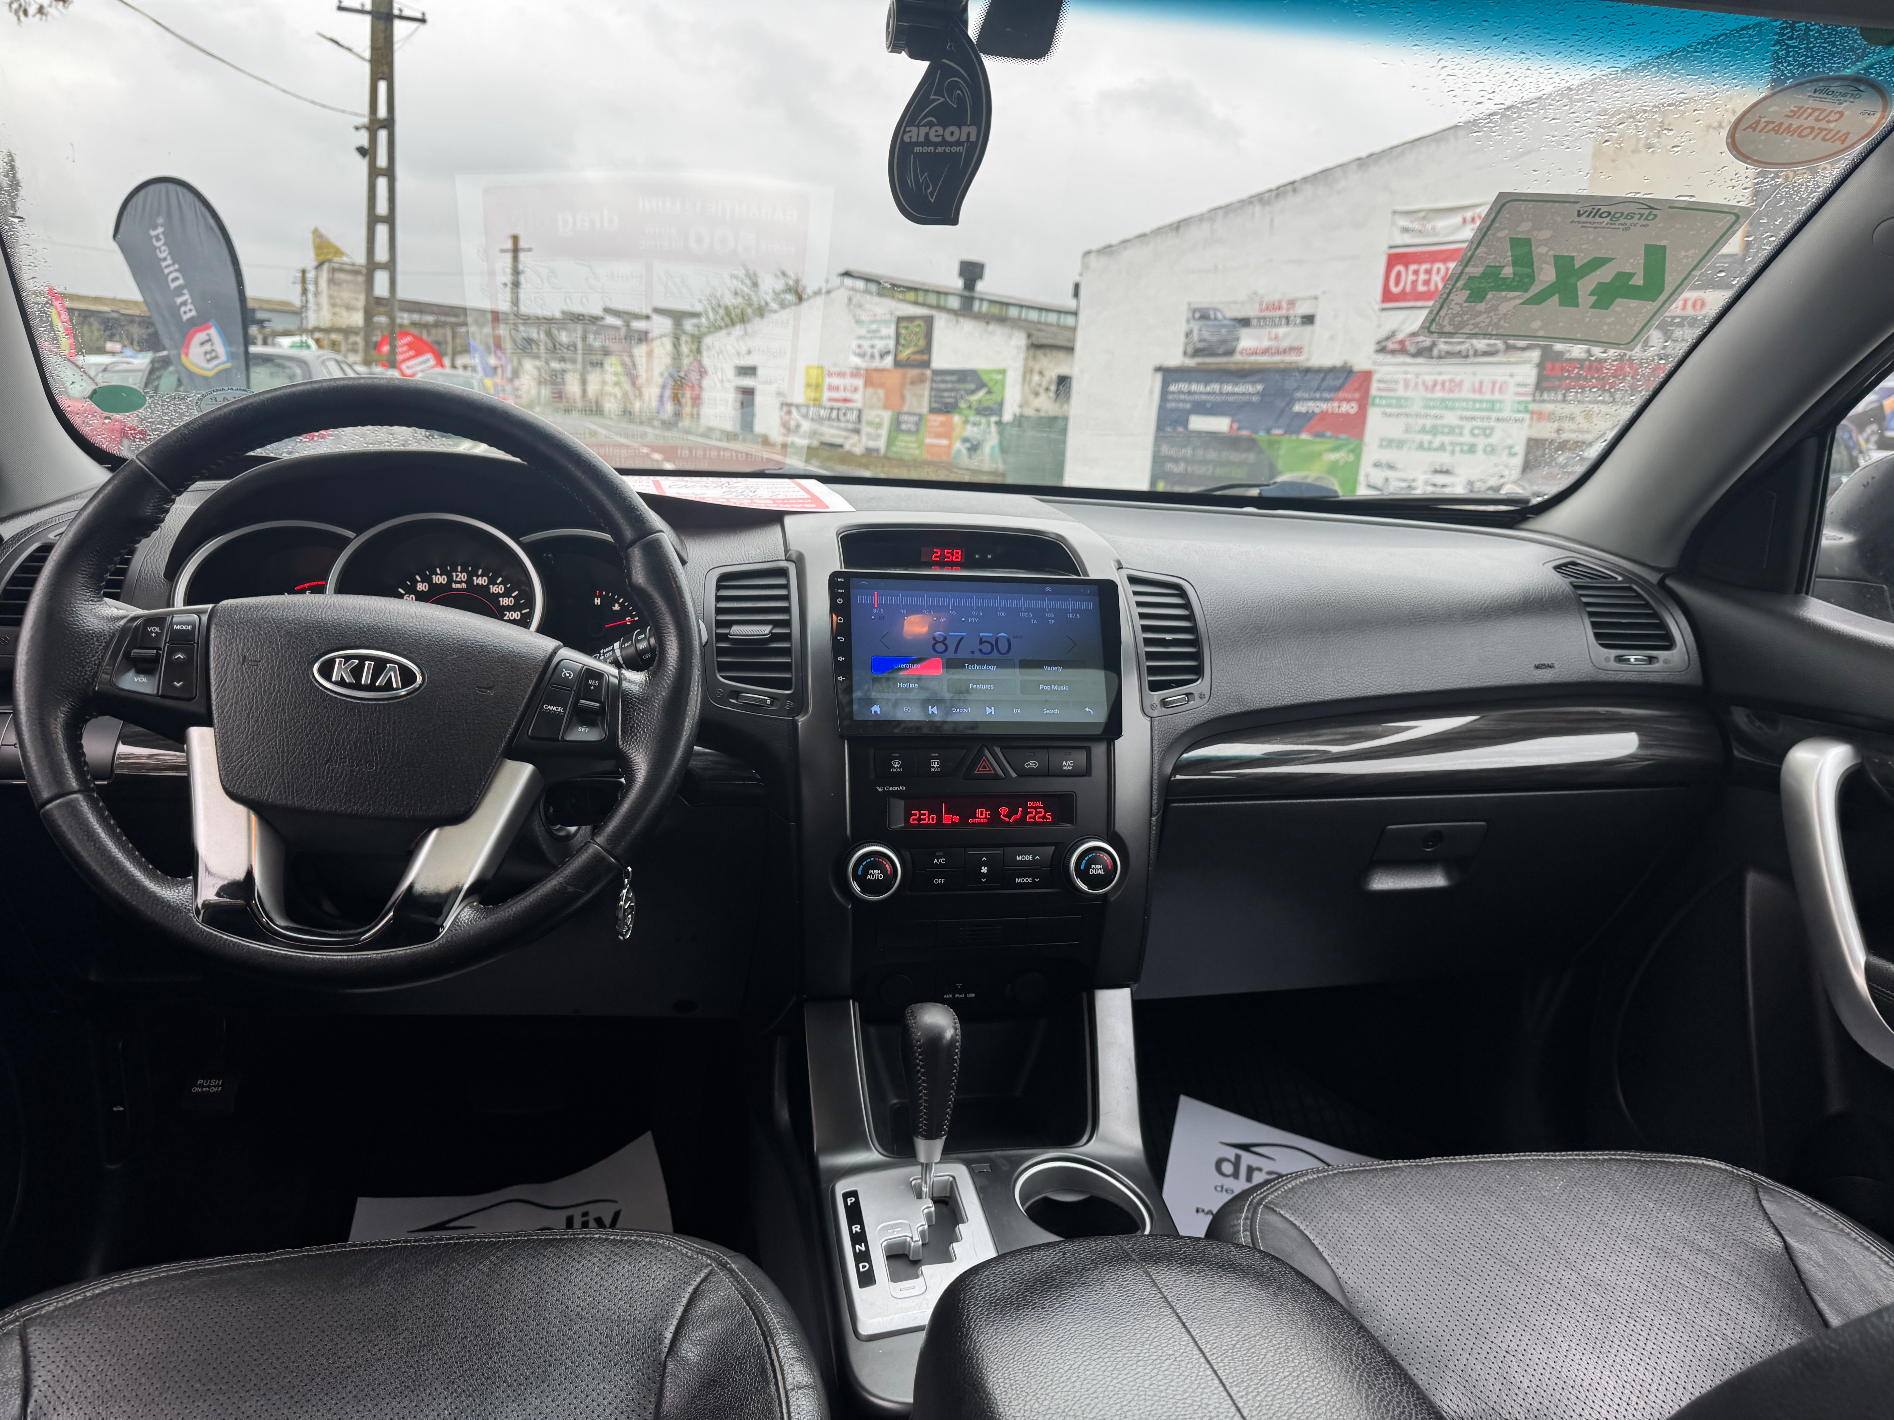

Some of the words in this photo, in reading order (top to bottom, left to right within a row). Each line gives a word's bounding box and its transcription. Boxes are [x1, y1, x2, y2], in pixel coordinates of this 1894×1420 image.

[903, 125, 977, 142] areon
[1468, 379, 1509, 396] AUTO
[1292, 401, 1358, 415] AUTOVIT.RO
[1470, 425, 1495, 438] CU
[431, 575, 447, 584] 100
[452, 572, 467, 581] 120
[472, 576, 488, 586] 140
[416, 582, 429, 592] 80
[489, 584, 505, 594] 160
[498, 597, 515, 606] 180
[594, 597, 601, 606] H
[503, 611, 521, 620] 200
[931, 631, 1012, 656] 87.50
[964, 663, 997, 672] Technology
[332, 659, 402, 689] KIA
[1039, 684, 1051, 692] Pop
[543, 704, 565, 713] CANCEL
[910, 810, 937, 824] 23.0
[1026, 808, 1052, 823] 22.5
[866, 873, 884, 881] AUTO
[847, 1197, 856, 1206] P
[852, 1224, 862, 1234] R
[855, 1243, 866, 1253] N
[859, 1262, 870, 1272] D
